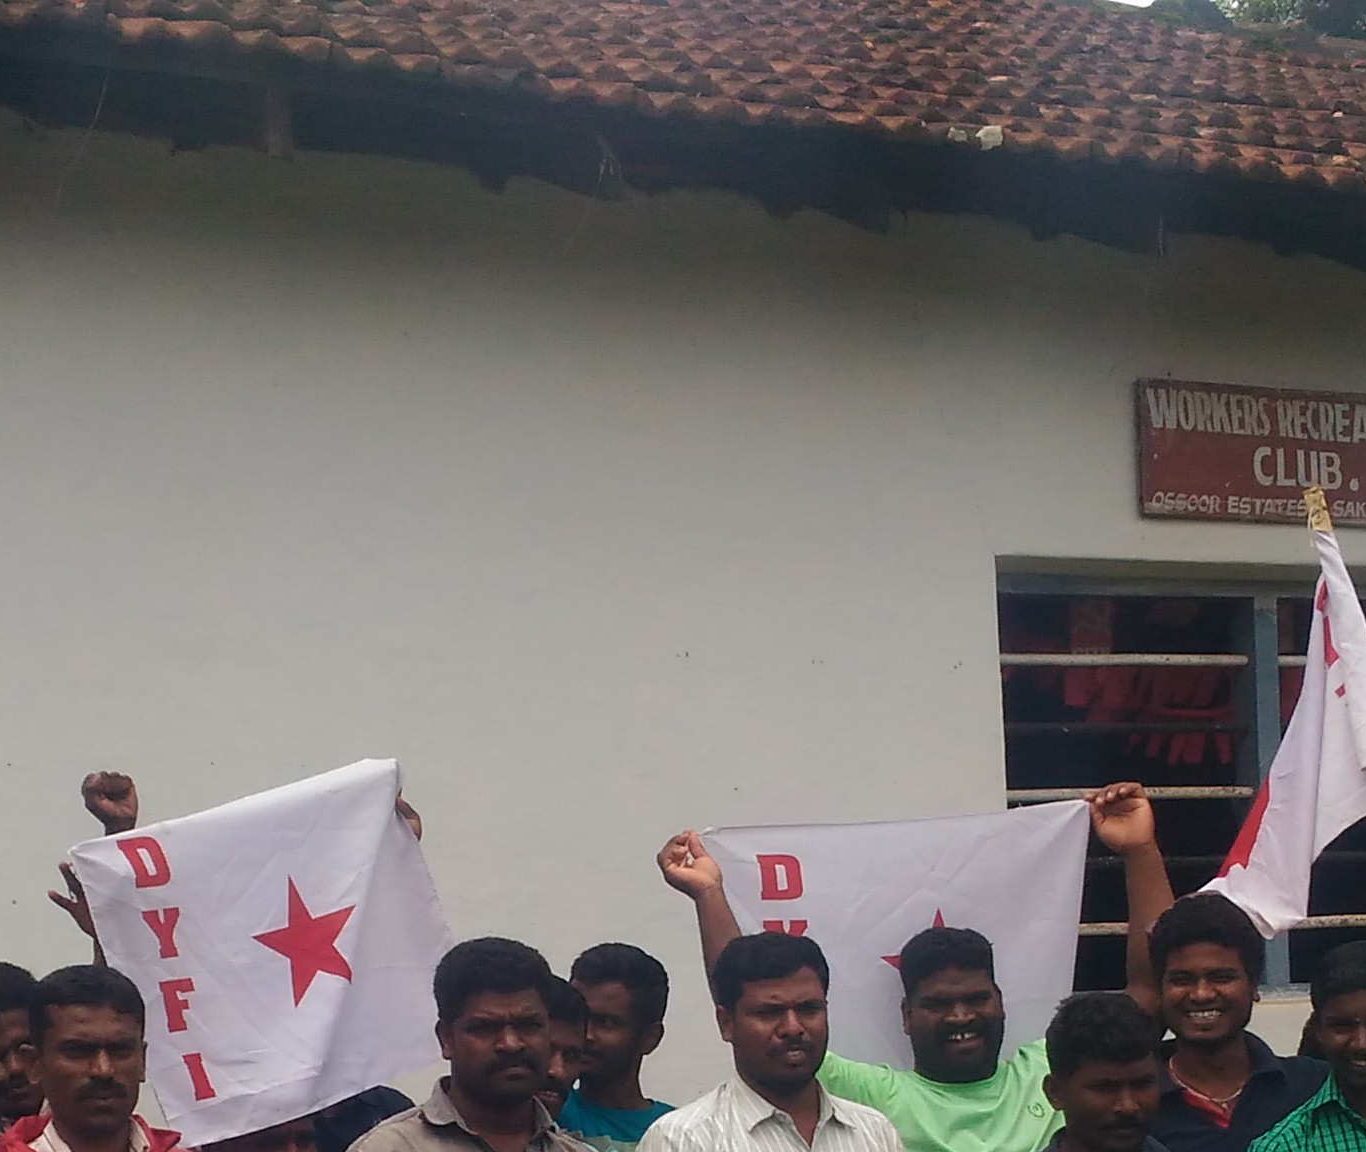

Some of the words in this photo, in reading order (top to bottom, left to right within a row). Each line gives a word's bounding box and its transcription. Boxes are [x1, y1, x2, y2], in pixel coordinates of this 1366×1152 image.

[1146, 387, 1272, 437] WORKERS
[1253, 447, 1360, 491] CLUB.
[1227, 495, 1307, 518] ESTATES
[116, 836, 216, 1102] DYFI
